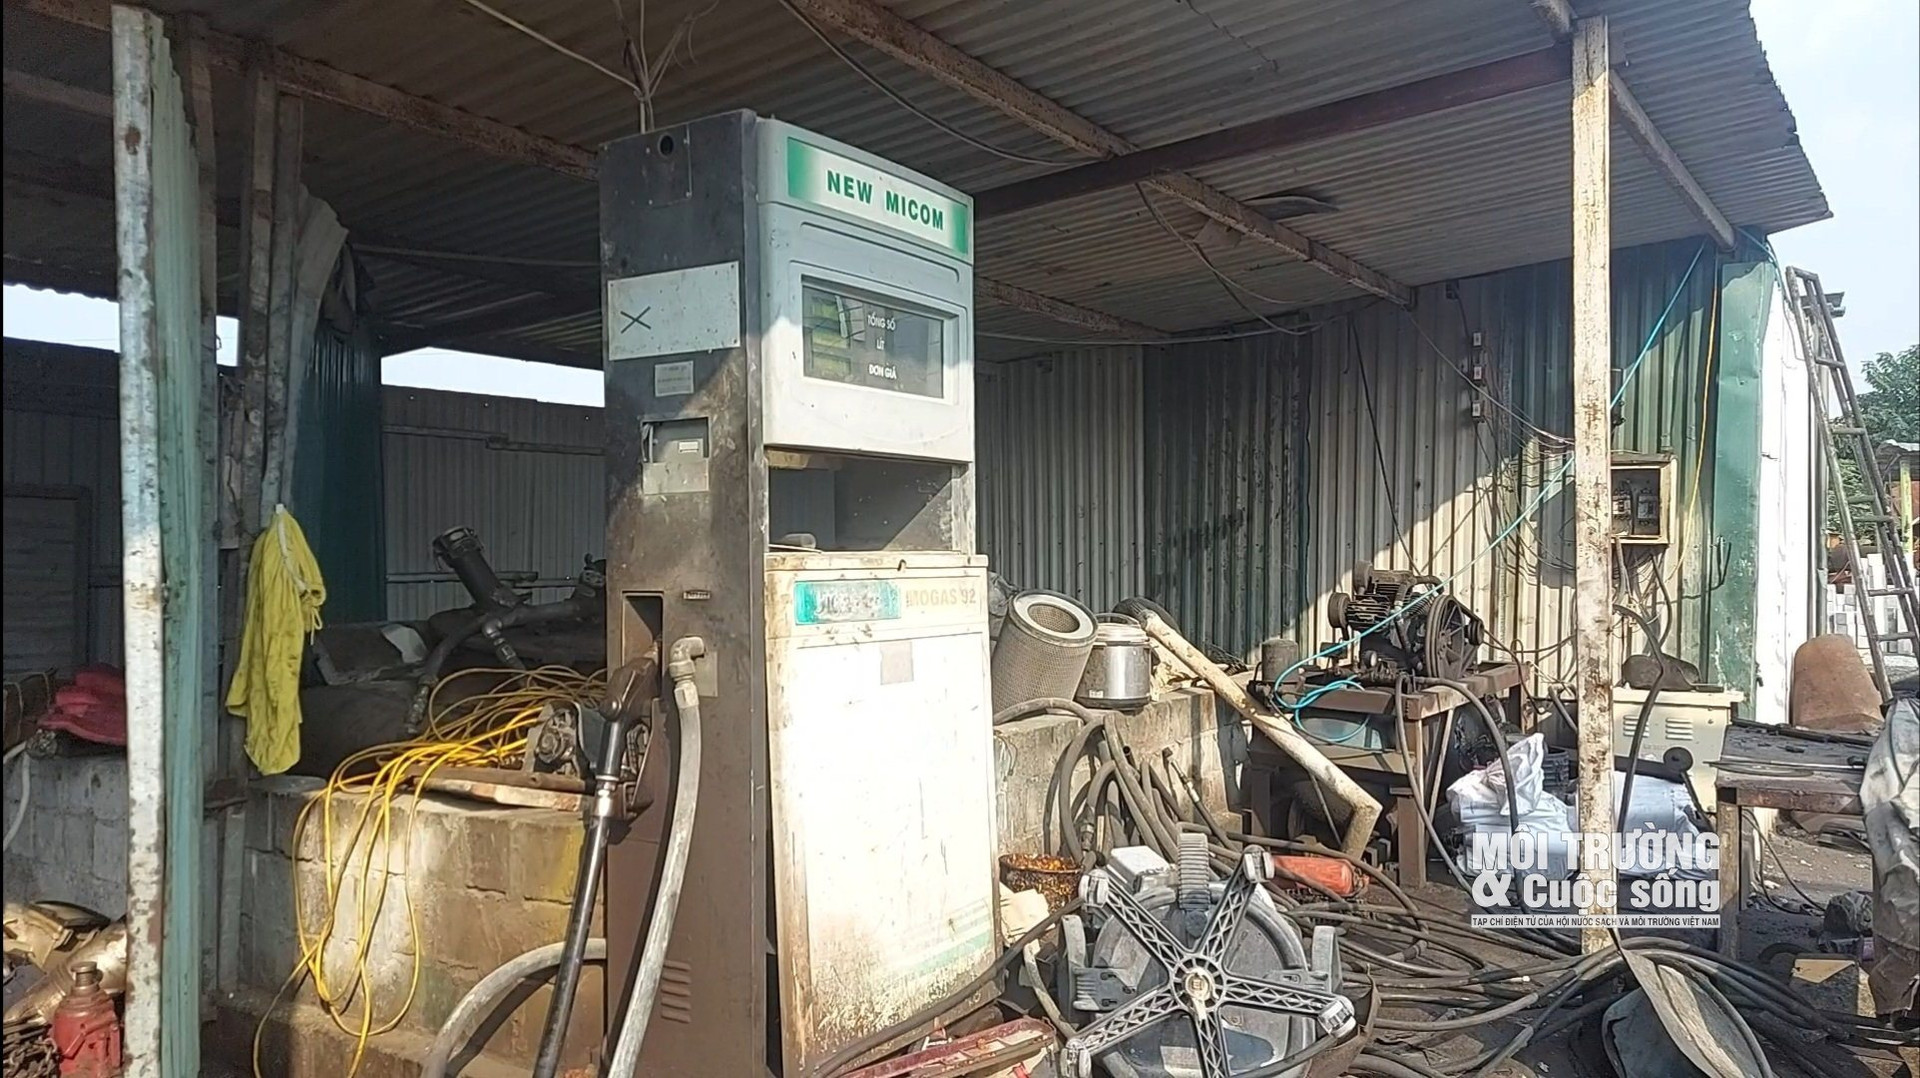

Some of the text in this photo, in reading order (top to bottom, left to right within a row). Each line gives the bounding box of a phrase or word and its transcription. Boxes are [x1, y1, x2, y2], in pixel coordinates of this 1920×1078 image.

[827, 169, 944, 231] NEW MICOM
[886, 315, 896, 331] SỐ
[884, 364, 898, 380] GIÁ
[906, 587, 977, 607] MOGAS 92
